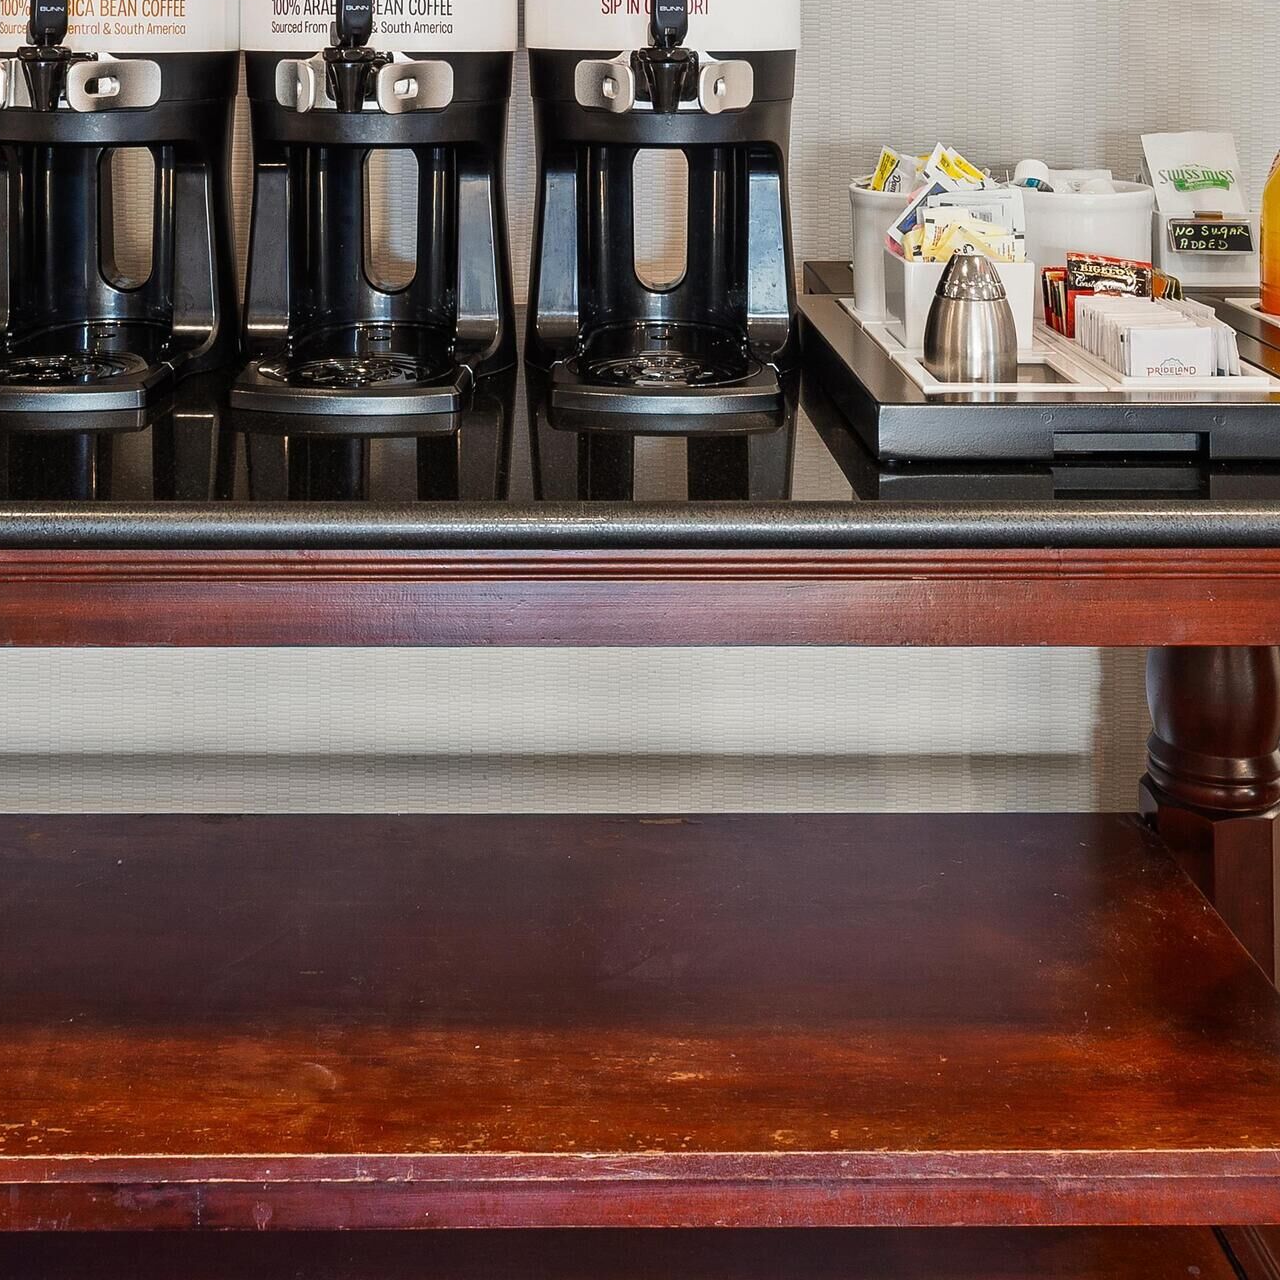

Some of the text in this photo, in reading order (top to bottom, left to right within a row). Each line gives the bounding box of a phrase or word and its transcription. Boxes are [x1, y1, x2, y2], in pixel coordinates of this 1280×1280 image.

[142, 0, 186, 17] COFFEE
[0, 22, 186, 35] Source entral & South America
[271, 21, 302, 33] Sourced
[305, 21, 327, 33] From
[381, 21, 411, 33] South
[413, 21, 453, 34] America
[1175, 225, 1194, 236] NO
[1180, 238, 1228, 249] ADDED
[1079, 263, 1136, 277] BIGELOW
[1147, 366, 1196, 376] PRIDELAND
